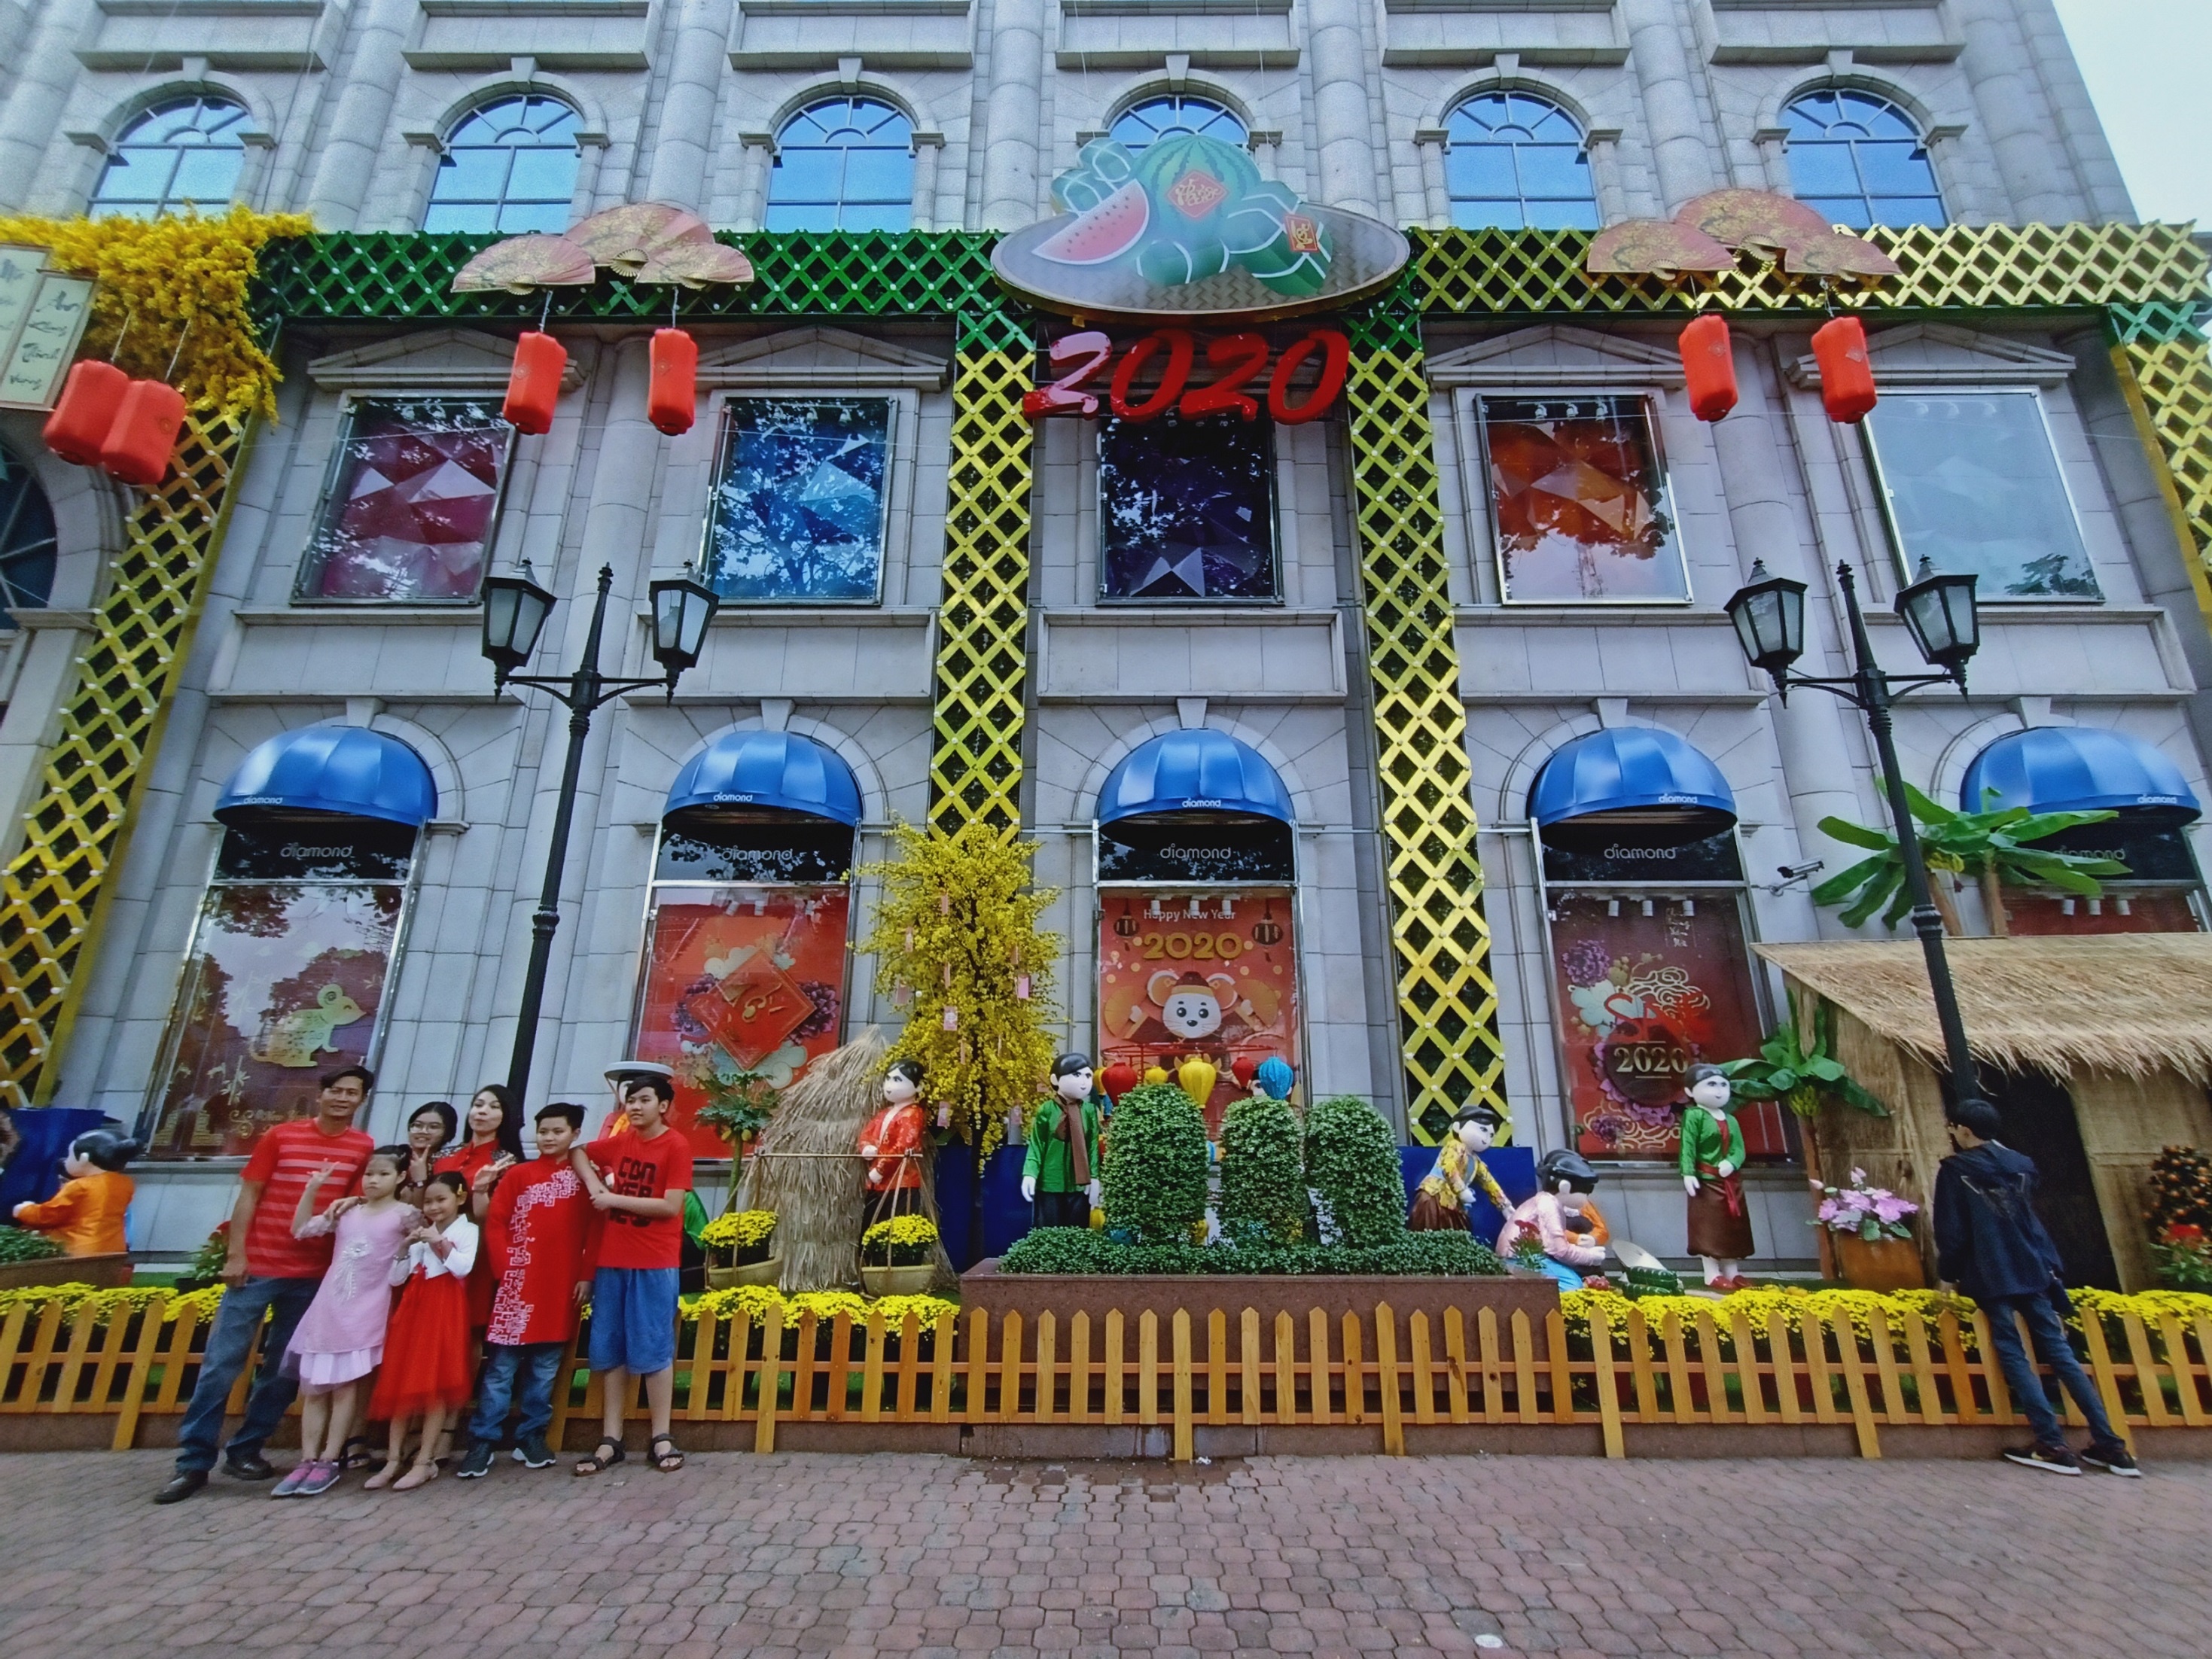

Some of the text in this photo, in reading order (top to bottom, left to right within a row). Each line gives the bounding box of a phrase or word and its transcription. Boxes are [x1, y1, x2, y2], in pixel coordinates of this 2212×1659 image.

[1023, 329, 1350, 425] 2020
[243, 795, 283, 805] diamond
[713, 791, 753, 802] diamond
[1181, 797, 1221, 808] diamond
[1658, 793, 1699, 804] diamond
[2137, 794, 2177, 804] diamond
[280, 842, 354, 858] diamond
[721, 845, 794, 861] diamond
[1159, 842, 1232, 860] diamond
[1604, 843, 1677, 860] diamond
[1142, 932, 1243, 960] 2020
[1613, 1046, 1689, 1073] 2020
